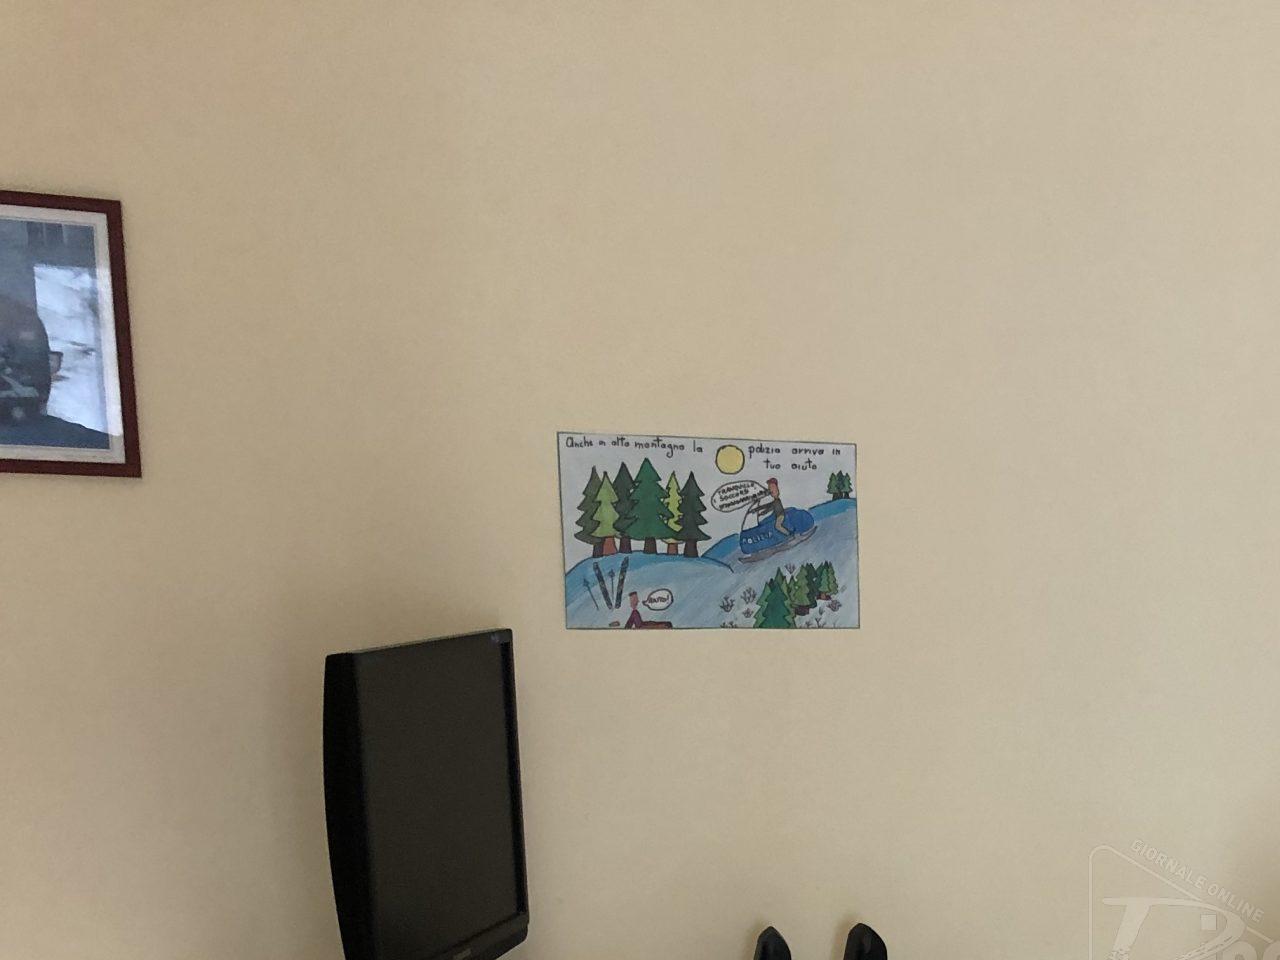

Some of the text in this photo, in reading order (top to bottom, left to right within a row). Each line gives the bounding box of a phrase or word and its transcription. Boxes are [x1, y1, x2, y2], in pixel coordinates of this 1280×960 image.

[566, 436, 593, 448] Anche
[693, 440, 703, 452] la
[792, 447, 824, 455] arriva
[763, 458, 781, 469] tuo
